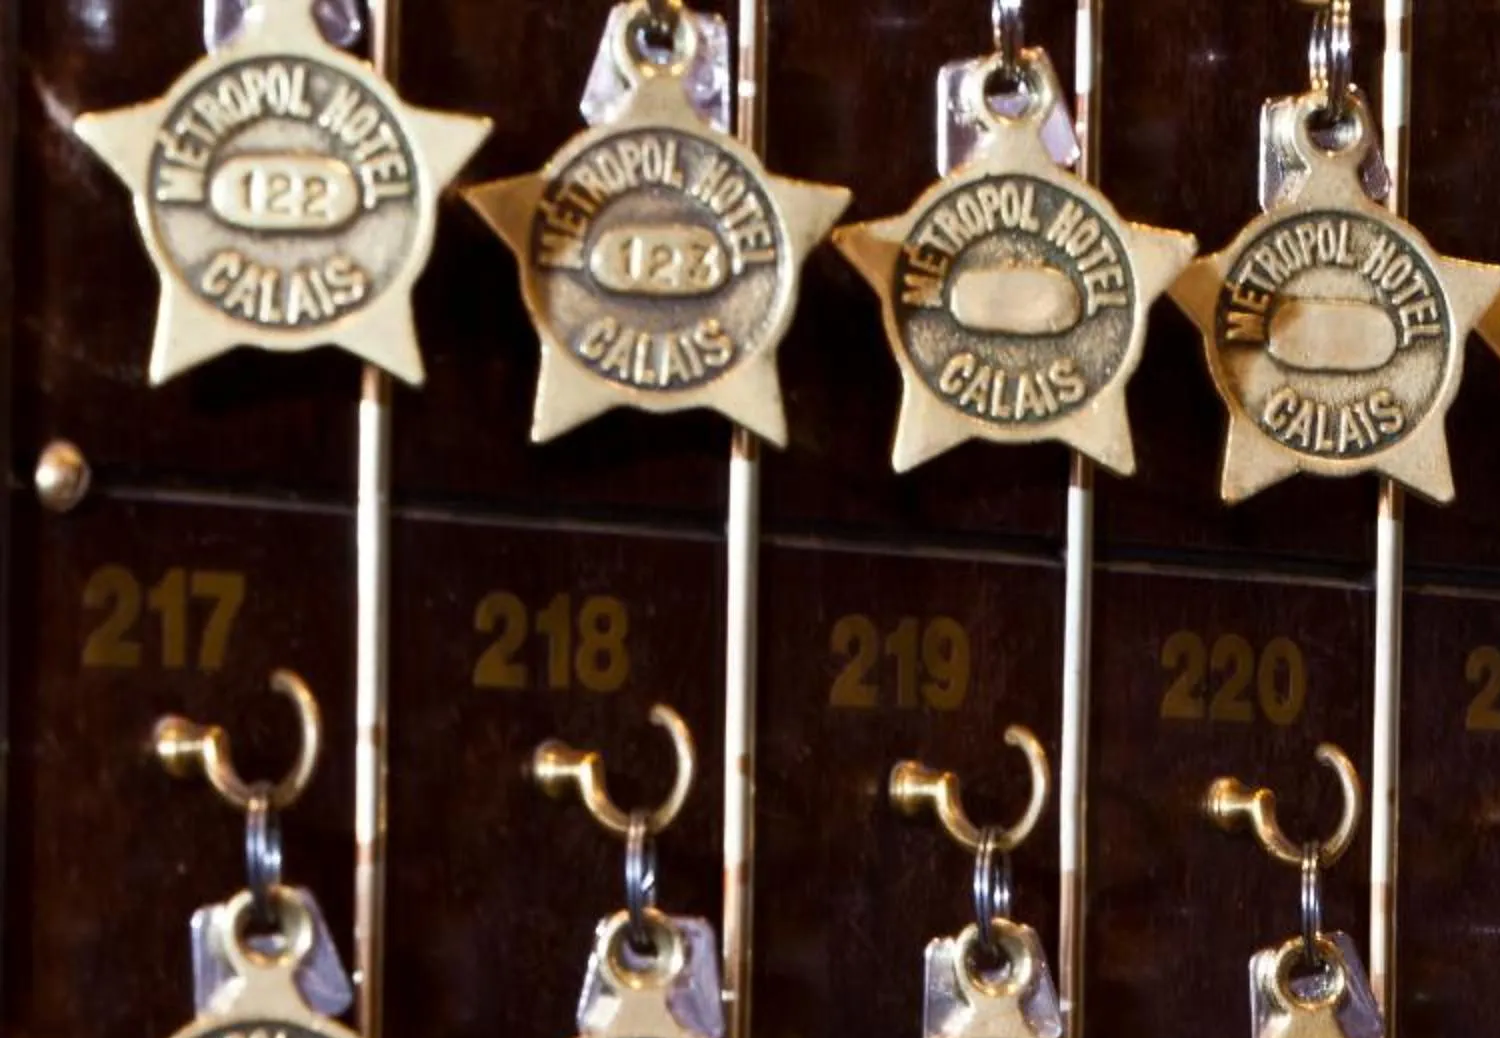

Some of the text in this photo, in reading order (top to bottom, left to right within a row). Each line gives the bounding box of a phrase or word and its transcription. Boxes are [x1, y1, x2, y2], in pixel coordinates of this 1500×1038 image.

[319, 82, 410, 208] HOTEL
[243, 173, 327, 217] 122
[690, 153, 774, 274] HOTEL
[201, 251, 365, 323] CALAIS
[620, 238, 717, 281] 123
[1046, 199, 1127, 315] HOTEL
[1362, 233, 1442, 348] HOTEL
[579, 315, 732, 384] CALAIS
[938, 352, 1085, 419] CALAIS
[1263, 387, 1405, 452] CALAIS
[82, 566, 245, 669] 217
[472, 592, 630, 691] 218
[830, 614, 971, 709] 219
[1160, 631, 1307, 725] 220
